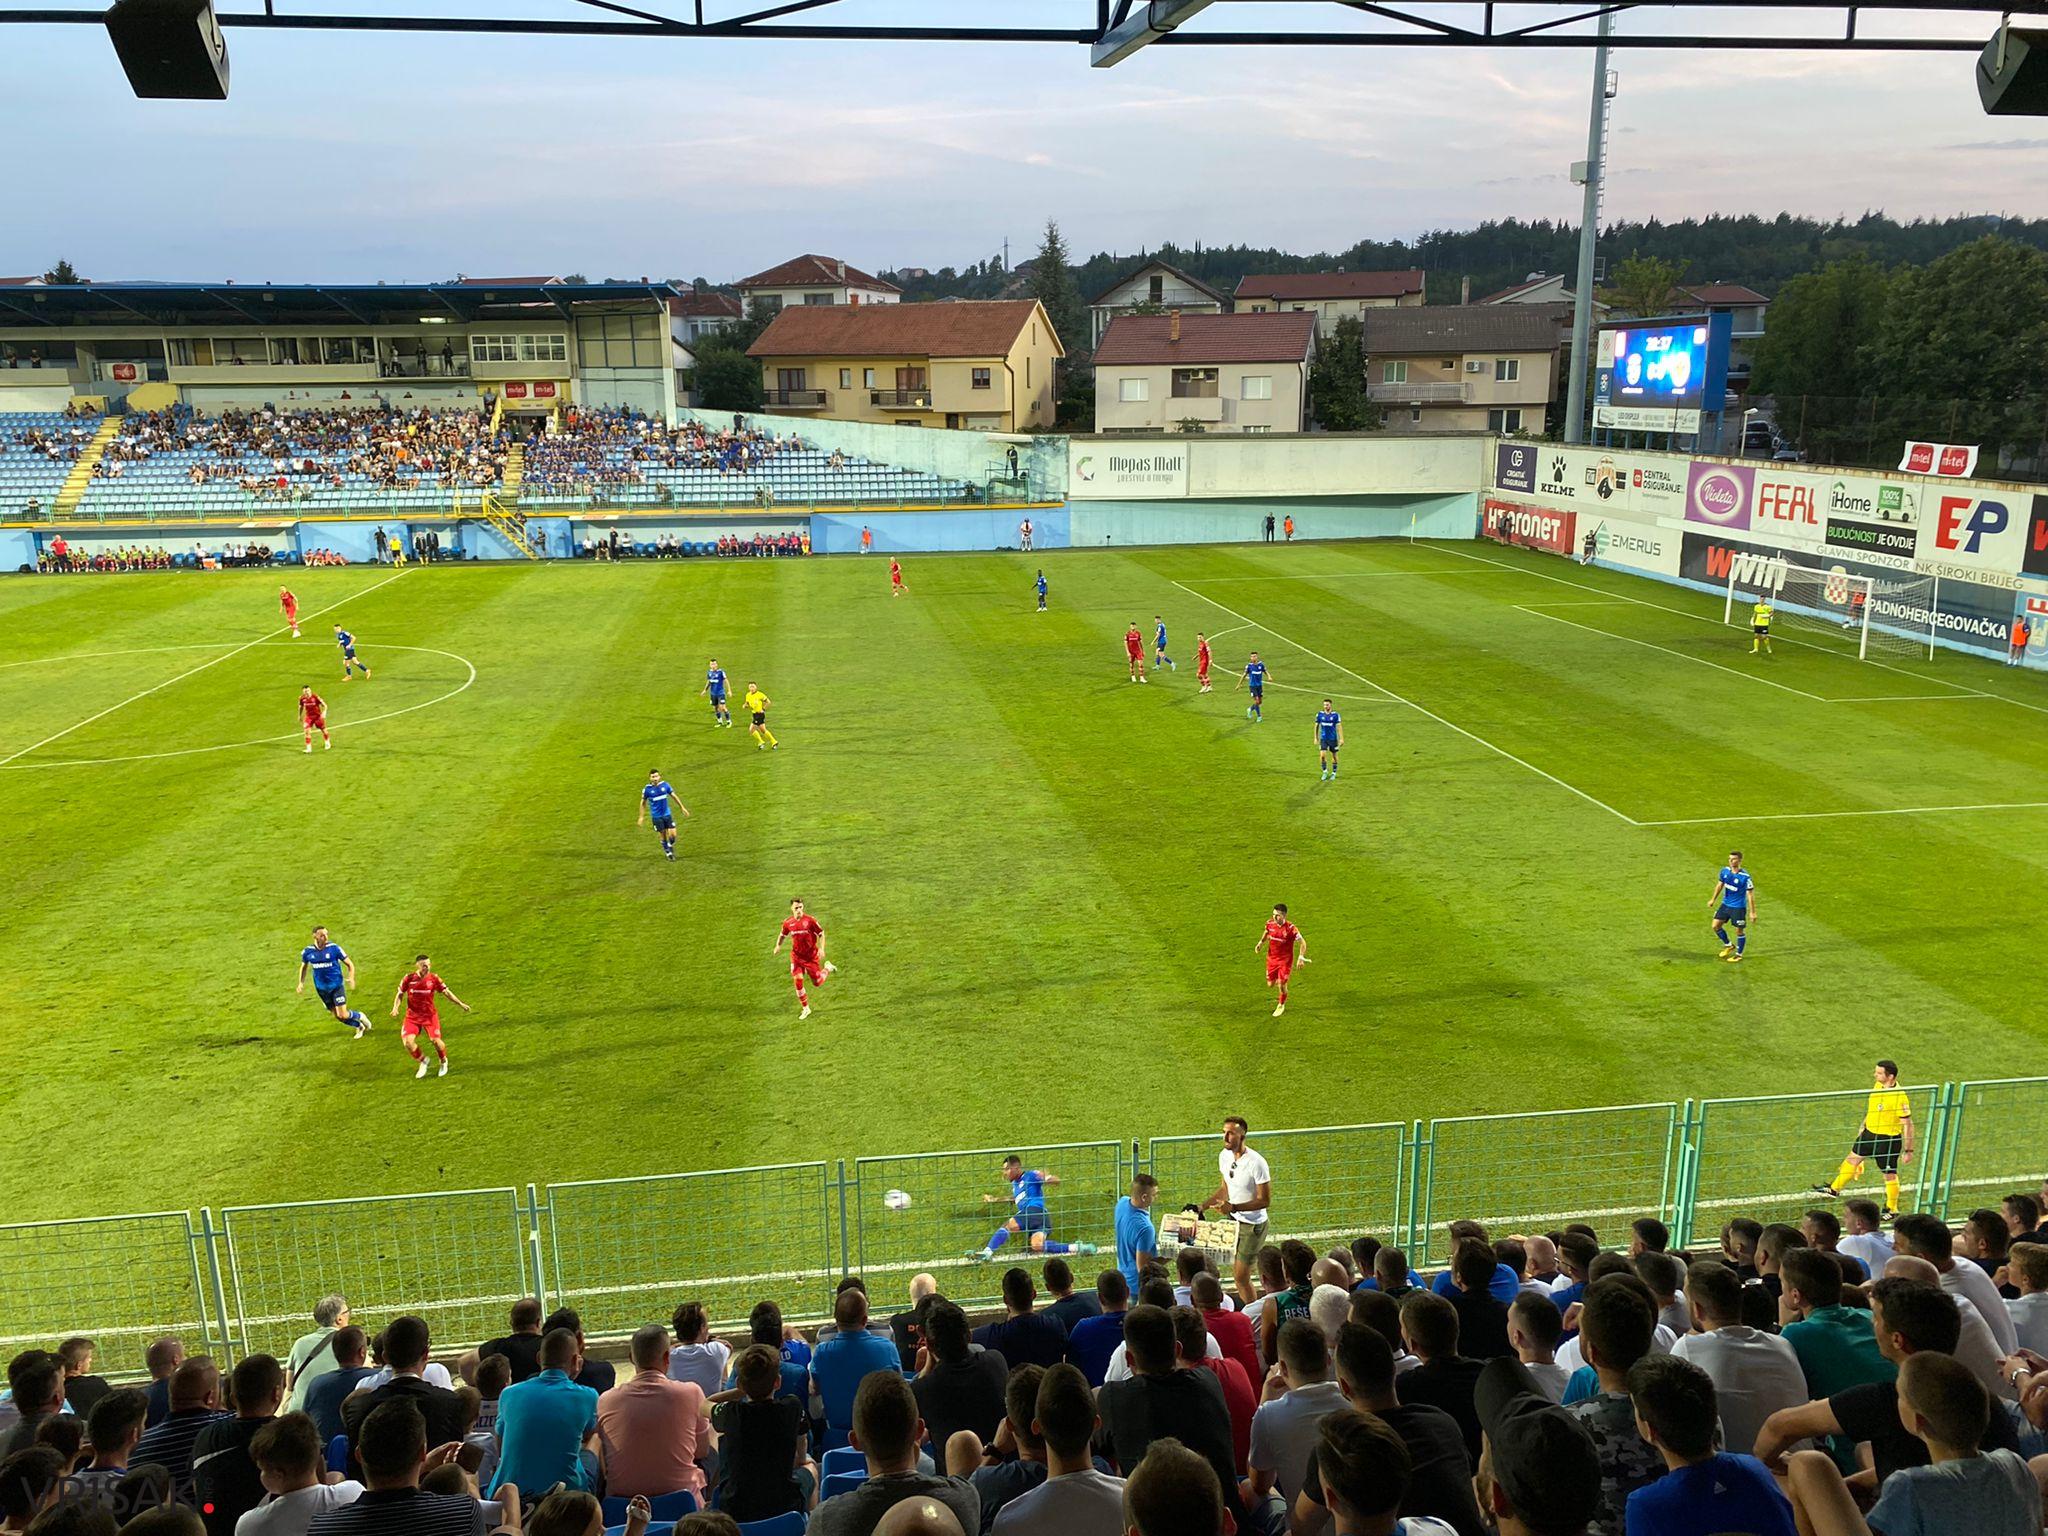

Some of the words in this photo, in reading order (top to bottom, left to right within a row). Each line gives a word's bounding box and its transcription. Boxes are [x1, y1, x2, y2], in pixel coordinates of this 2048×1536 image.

[1109, 456, 1151, 473] Mepas
[1154, 456, 1182, 471] Mall
[1642, 480, 1681, 494] OSIGURANJE
[1643, 470, 1671, 482] CENTRAL
[1540, 483, 1575, 497] KELME
[1703, 483, 1733, 505] Violeta
[1831, 490, 1871, 512] iHome
[1611, 534, 1662, 557] EMERUS
[1827, 526, 1877, 544] BUDUĆNOST
[1876, 533, 1886, 545] JE
[1886, 534, 1915, 550] OVDJE
[1816, 545, 1855, 562] GLAVNI
[1856, 551, 1911, 570] SPONZOR
[1915, 561, 1933, 575] NK
[1980, 572, 2025, 590] BRIJEG
